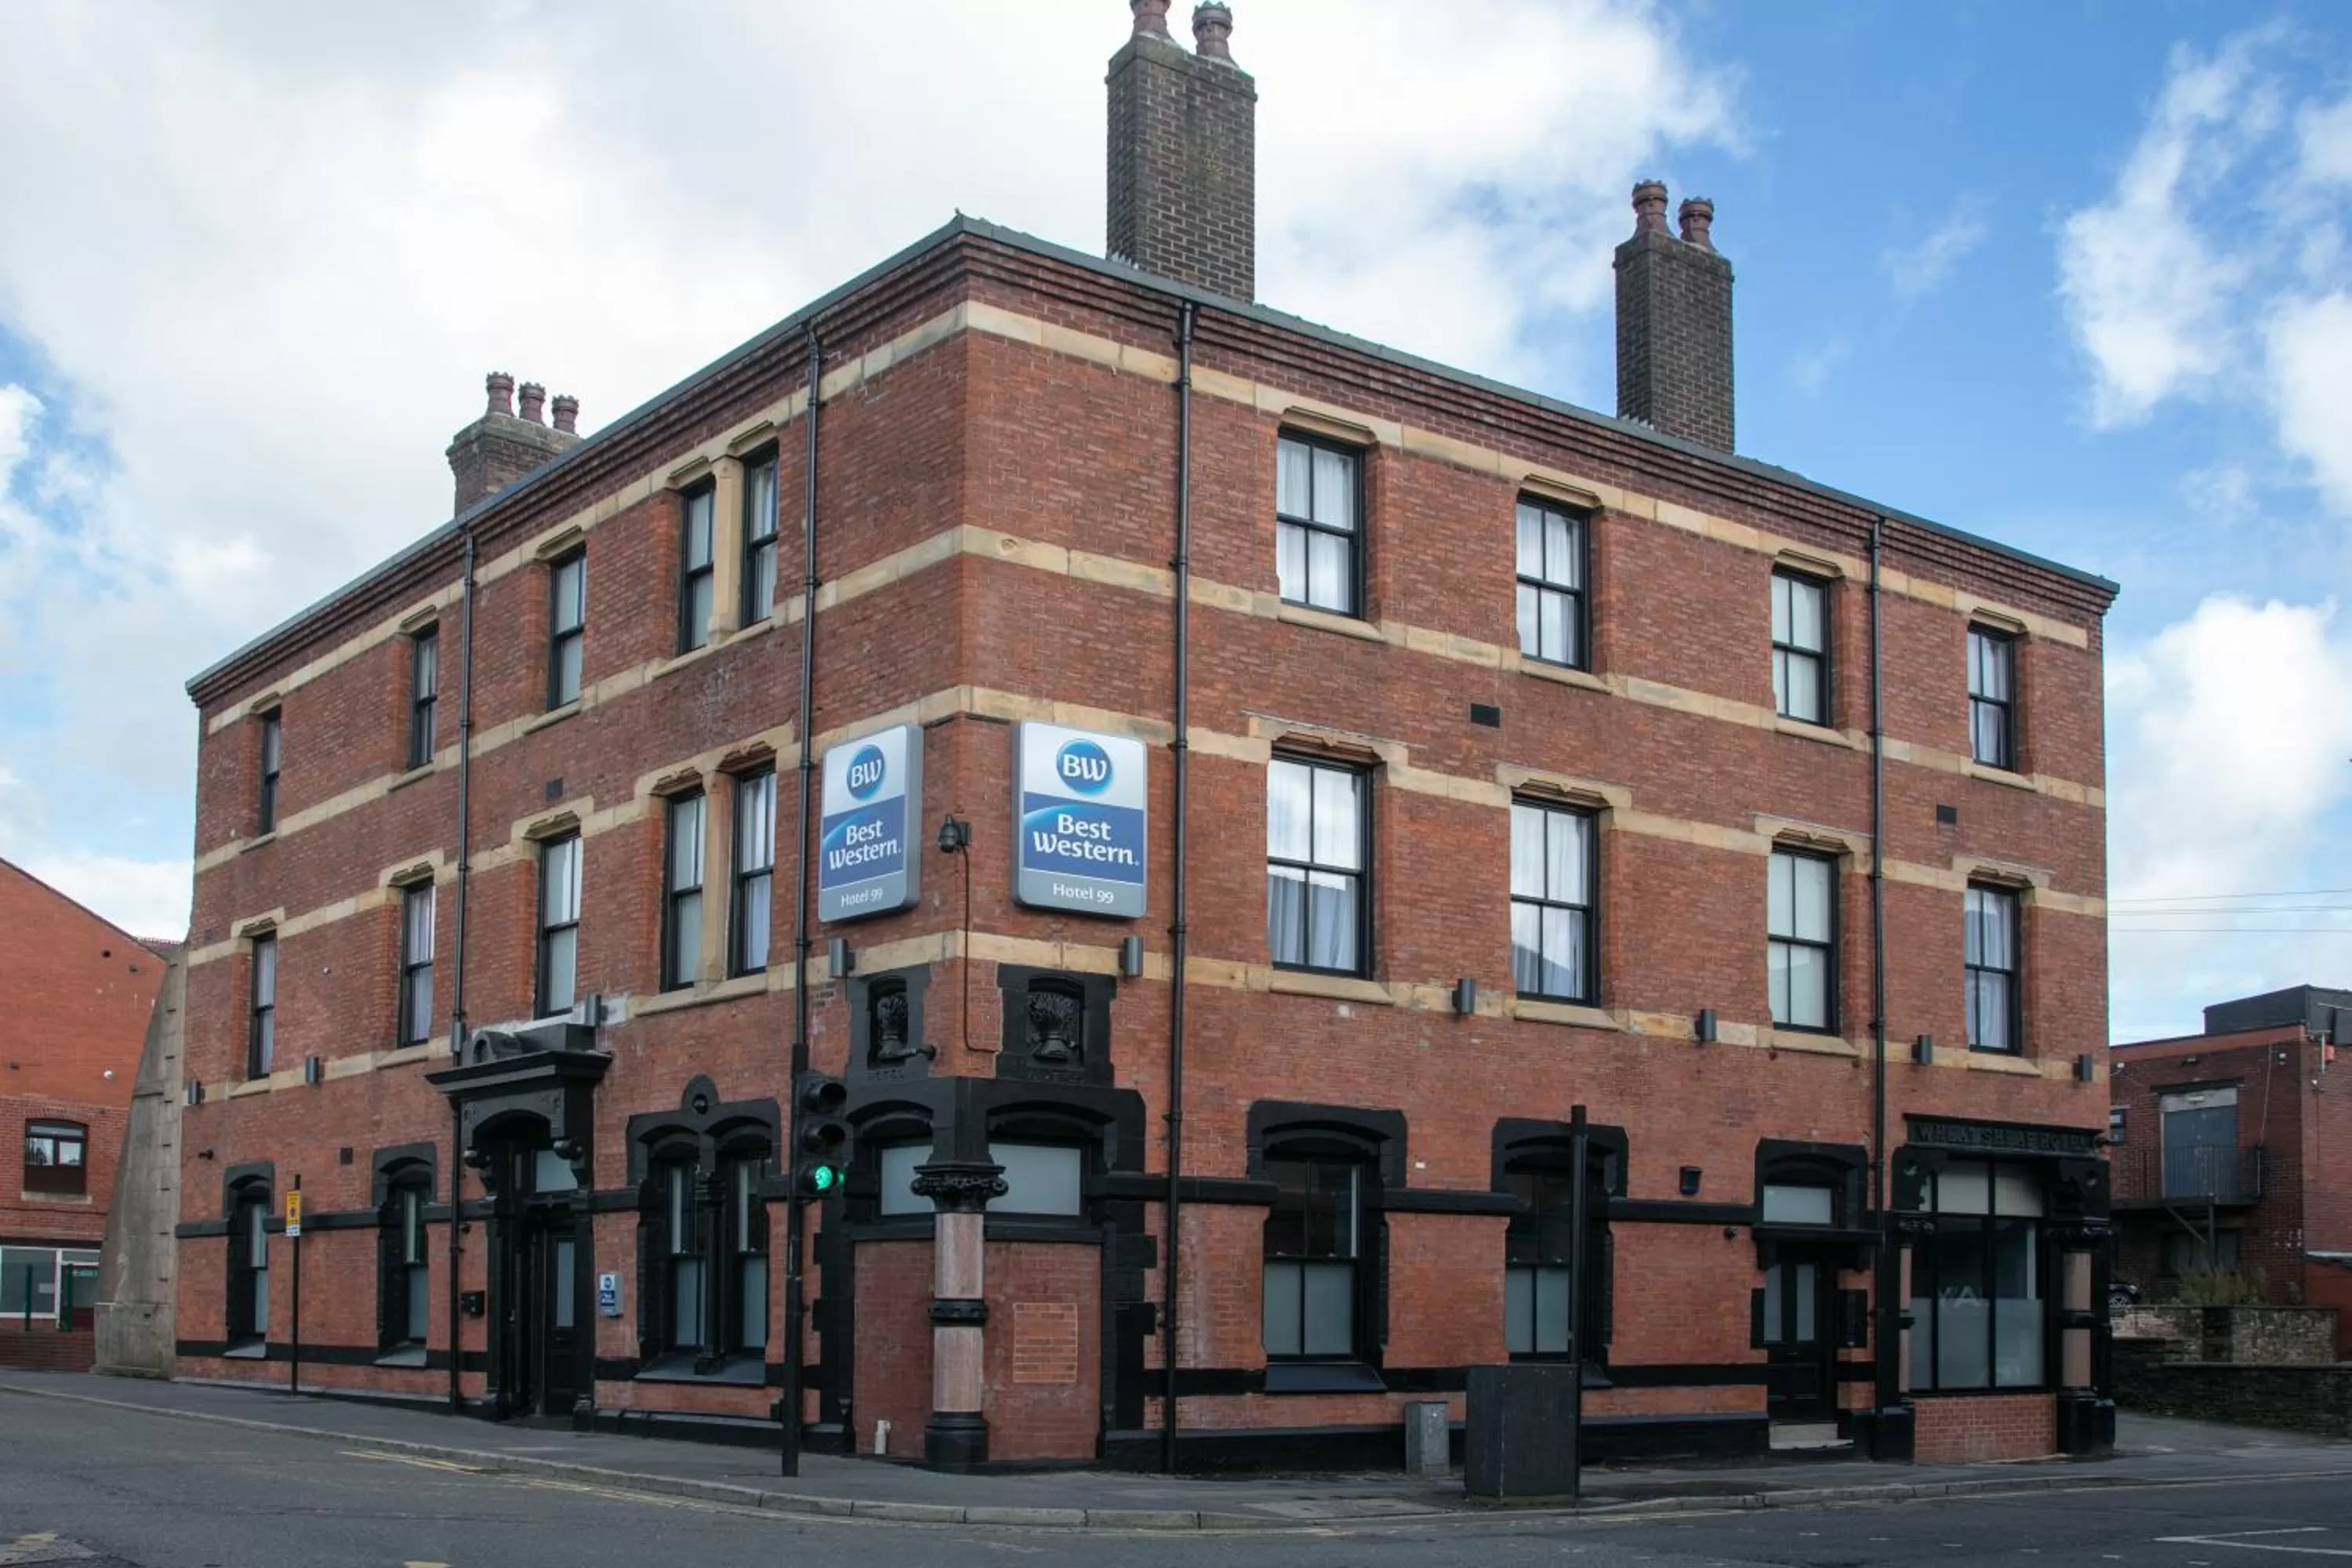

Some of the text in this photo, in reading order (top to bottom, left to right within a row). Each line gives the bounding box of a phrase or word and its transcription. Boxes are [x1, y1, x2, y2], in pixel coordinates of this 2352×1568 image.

[851, 758, 882, 788] BW
[1062, 753, 1107, 781] BW
[846, 819, 884, 846] Best
[1058, 813, 1111, 840] Best
[841, 887, 884, 908] Hotel 99
[1053, 882, 1114, 904] Hotel 99
